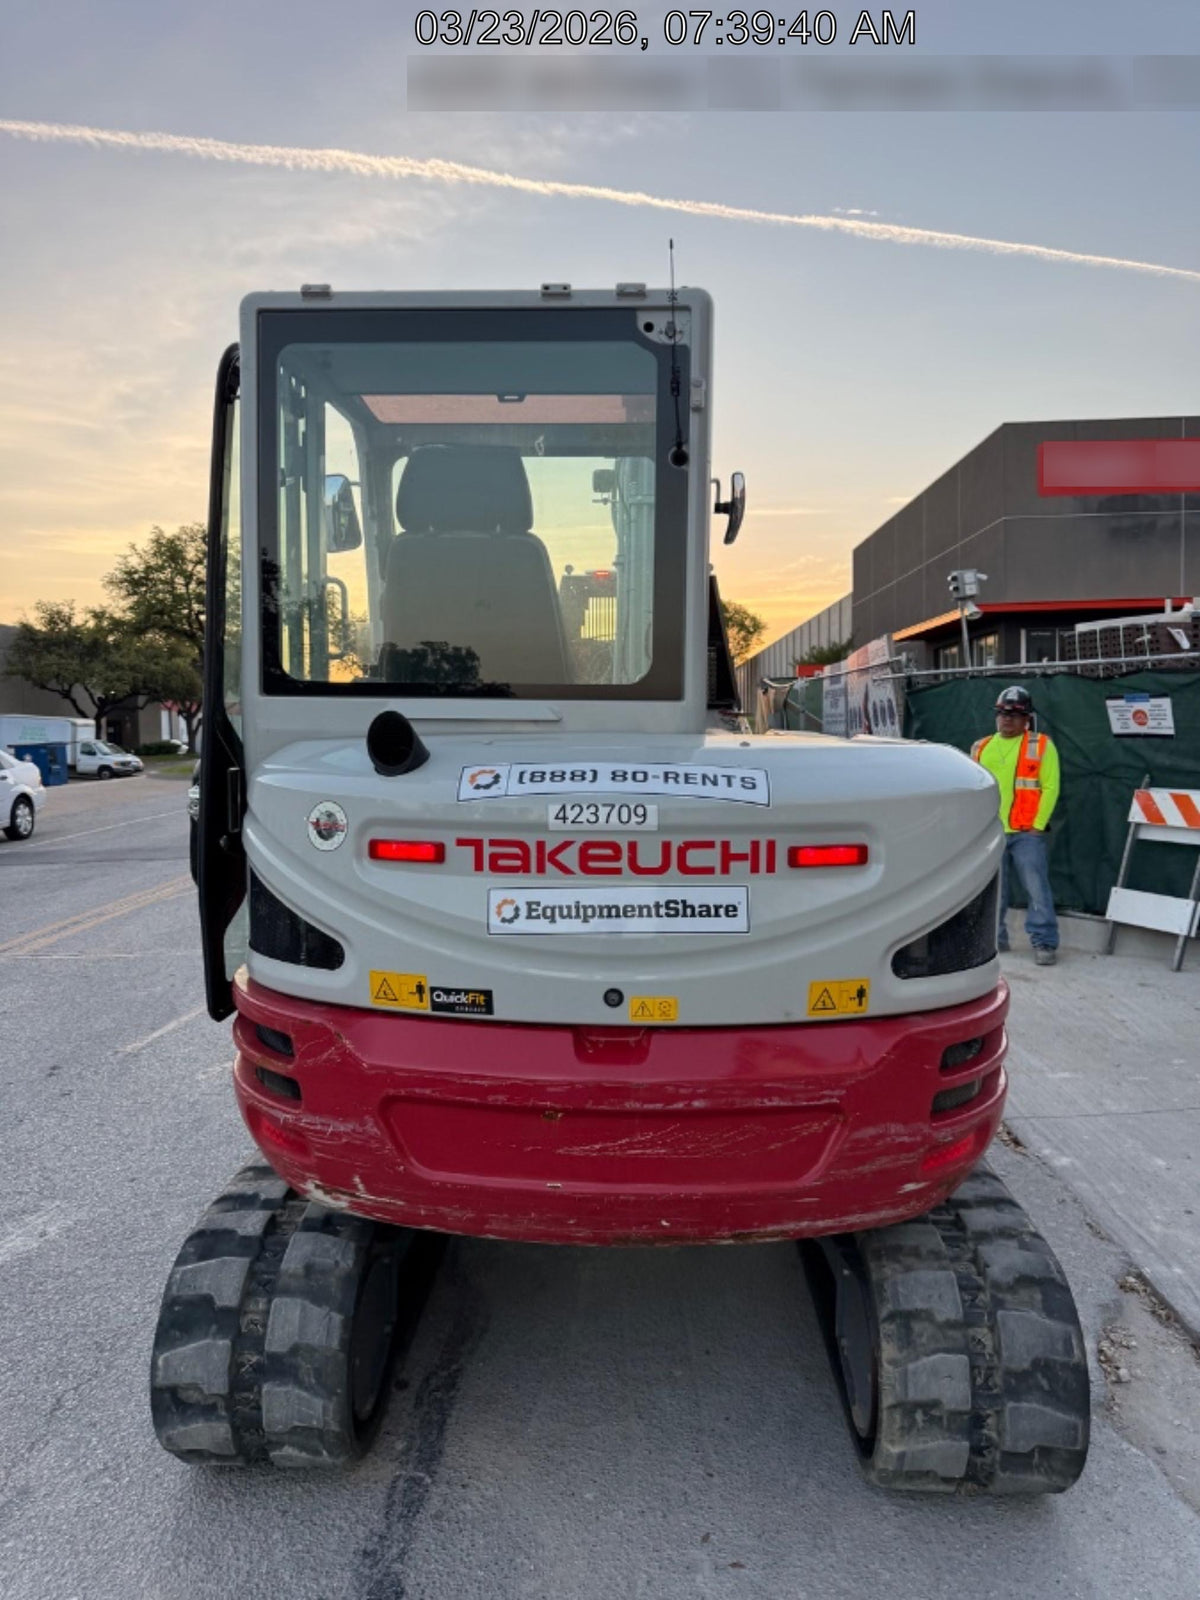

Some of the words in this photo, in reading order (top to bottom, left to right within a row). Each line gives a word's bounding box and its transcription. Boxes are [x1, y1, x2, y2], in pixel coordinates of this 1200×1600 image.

[517, 769, 598, 784] (888)
[610, 770, 757, 790] 80-RENTS
[553, 803, 648, 825] 423709
[525, 899, 740, 924] EquipmentShare
[433, 990, 486, 1006] QuickFit
